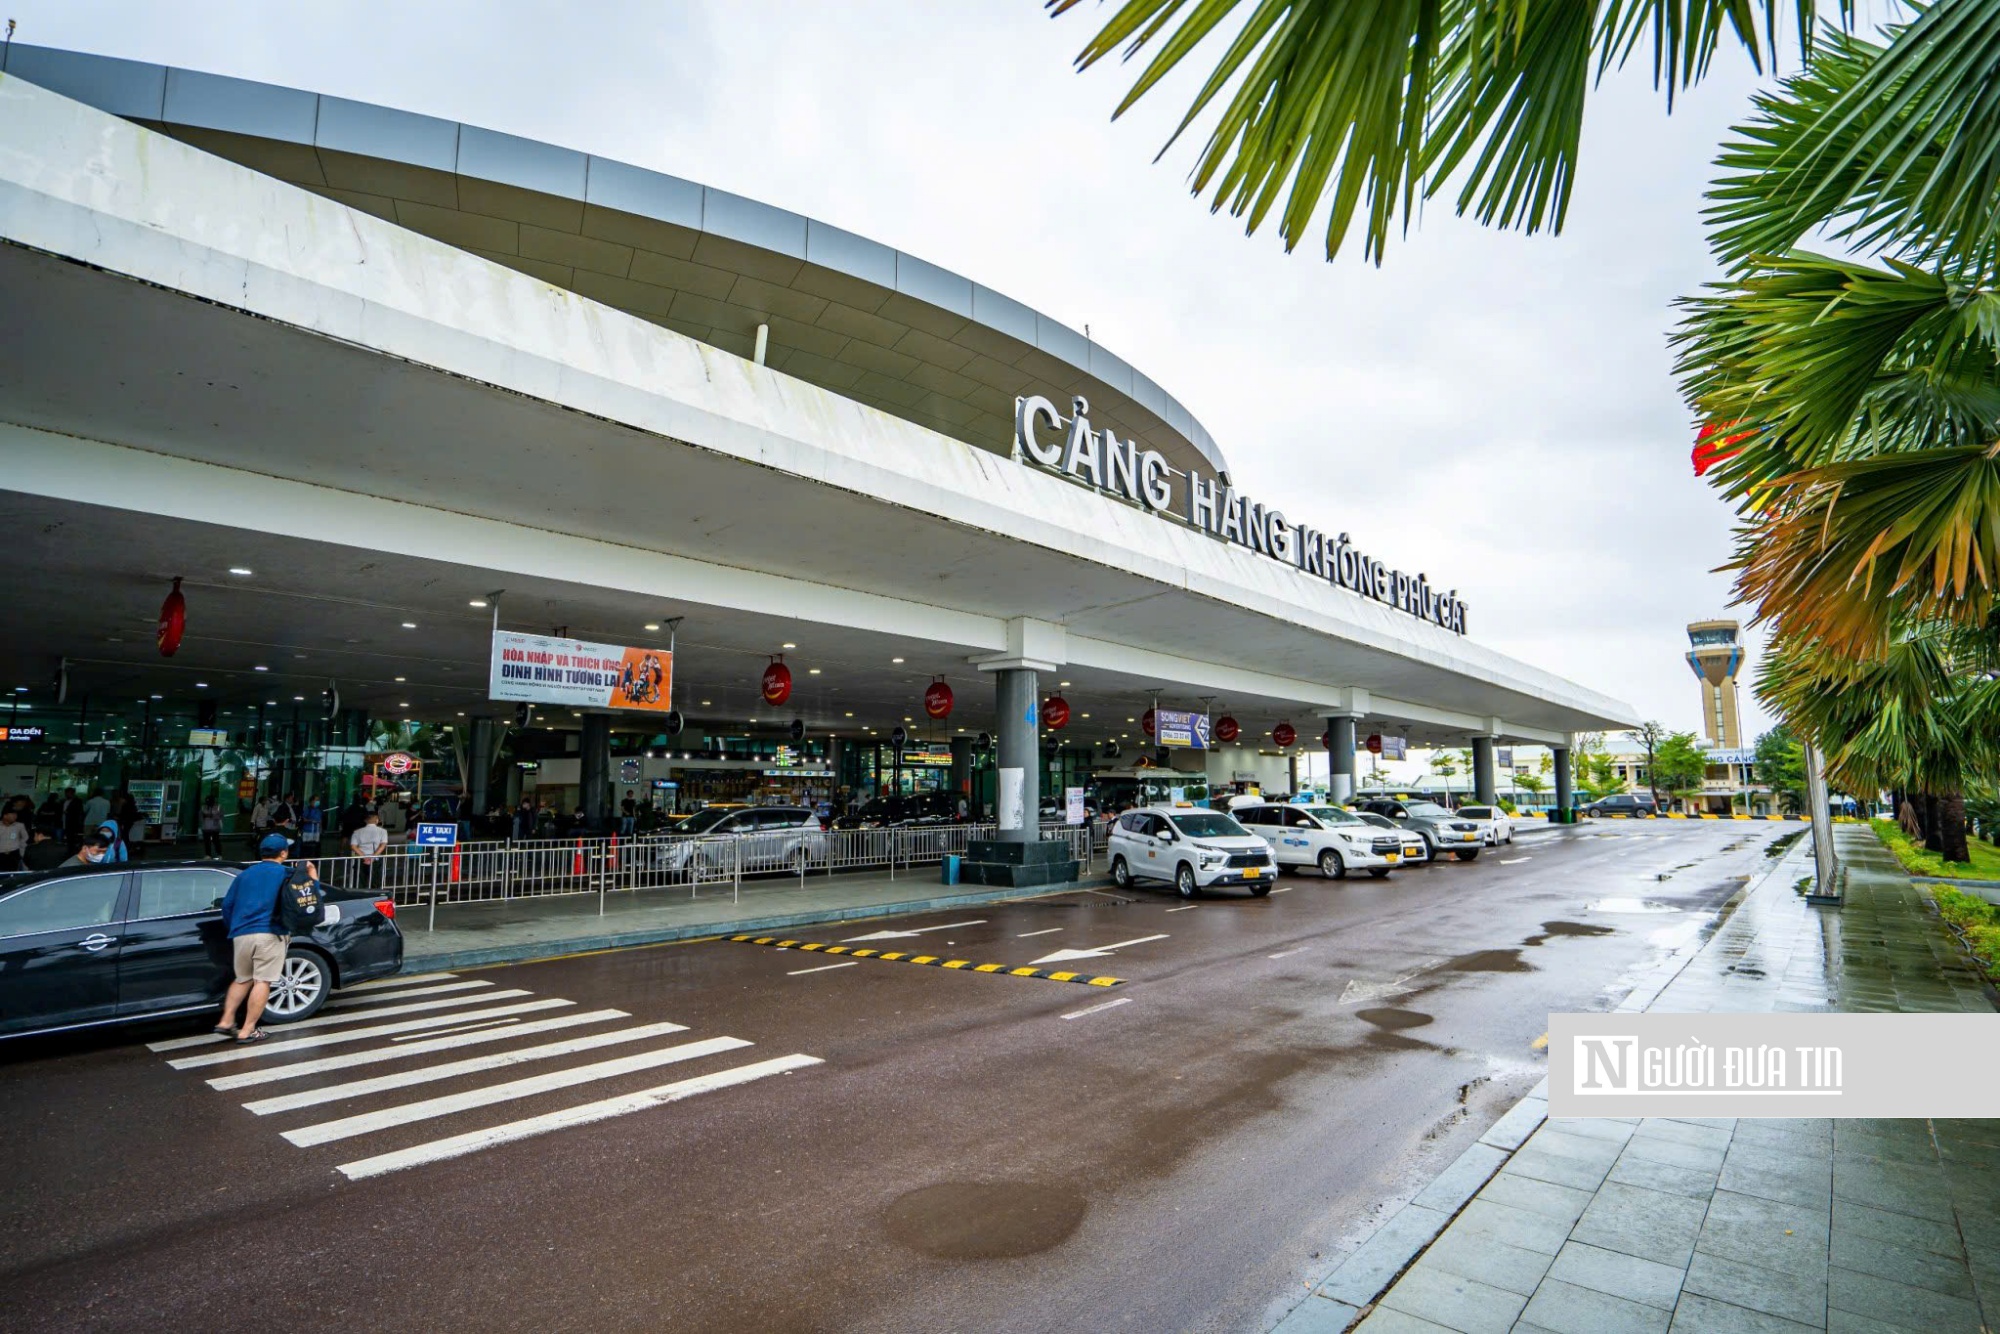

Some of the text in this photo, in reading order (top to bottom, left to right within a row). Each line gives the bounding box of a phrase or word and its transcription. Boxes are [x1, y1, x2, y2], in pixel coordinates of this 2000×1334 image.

[1016, 395, 1171, 511] CẢNG
[1186, 470, 1289, 561] HÀNG
[1298, 524, 1387, 602] KHÔNG
[1437, 589, 1469, 635] CÁT
[502, 647, 525, 662] HÒA
[556, 653, 570, 667] VÀ
[571, 655, 600, 670] THÍCH
[534, 664, 563, 683] HÌNH
[566, 669, 602, 686] TƯƠNG
[604, 674, 621, 688] LAI
[23, 726, 41, 735] ĐẾN
[422, 826, 433, 834] XE
[299, 886, 312, 896] 12
